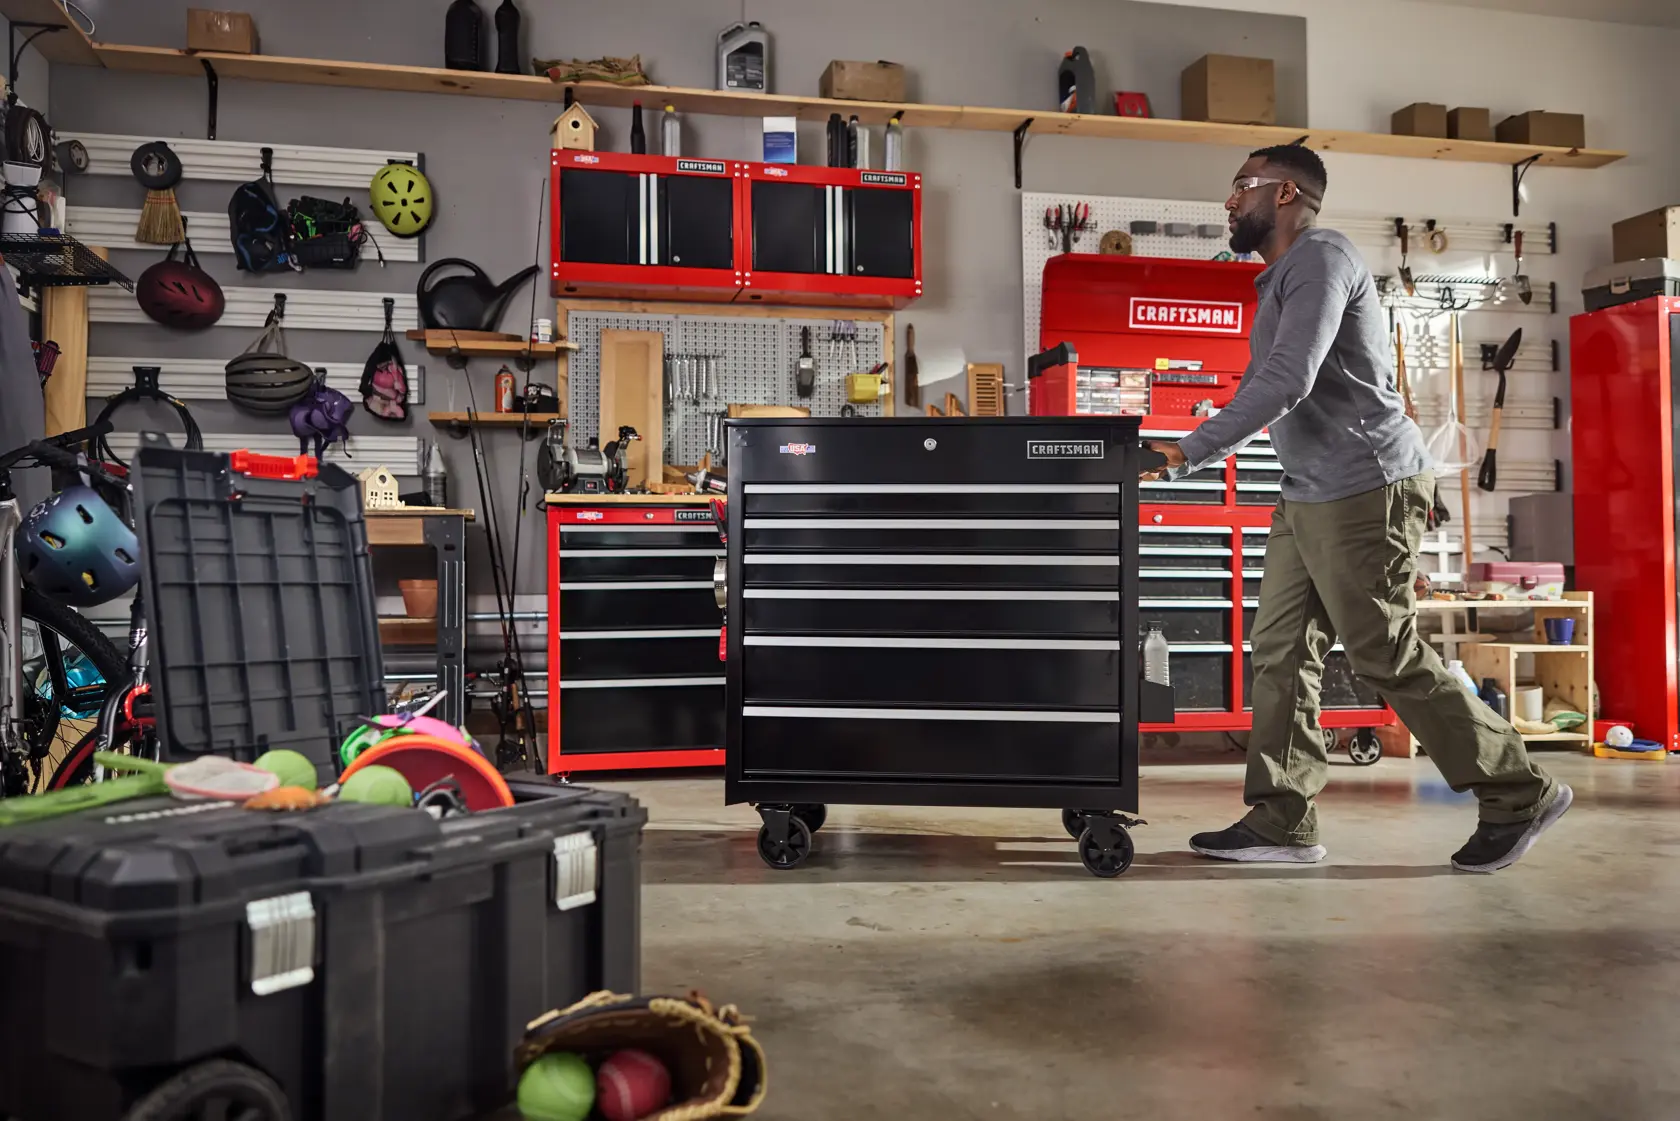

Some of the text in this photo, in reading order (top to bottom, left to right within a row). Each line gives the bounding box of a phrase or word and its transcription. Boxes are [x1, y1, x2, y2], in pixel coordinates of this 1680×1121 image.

[680, 162, 722, 171] CRAFTSMAN
[864, 174, 904, 183] CRAFTSMAN
[1137, 305, 1235, 325] CRAFTSMAN
[1032, 444, 1099, 455] CRAFTSMAN
[678, 512, 712, 520] CRAFTSM
